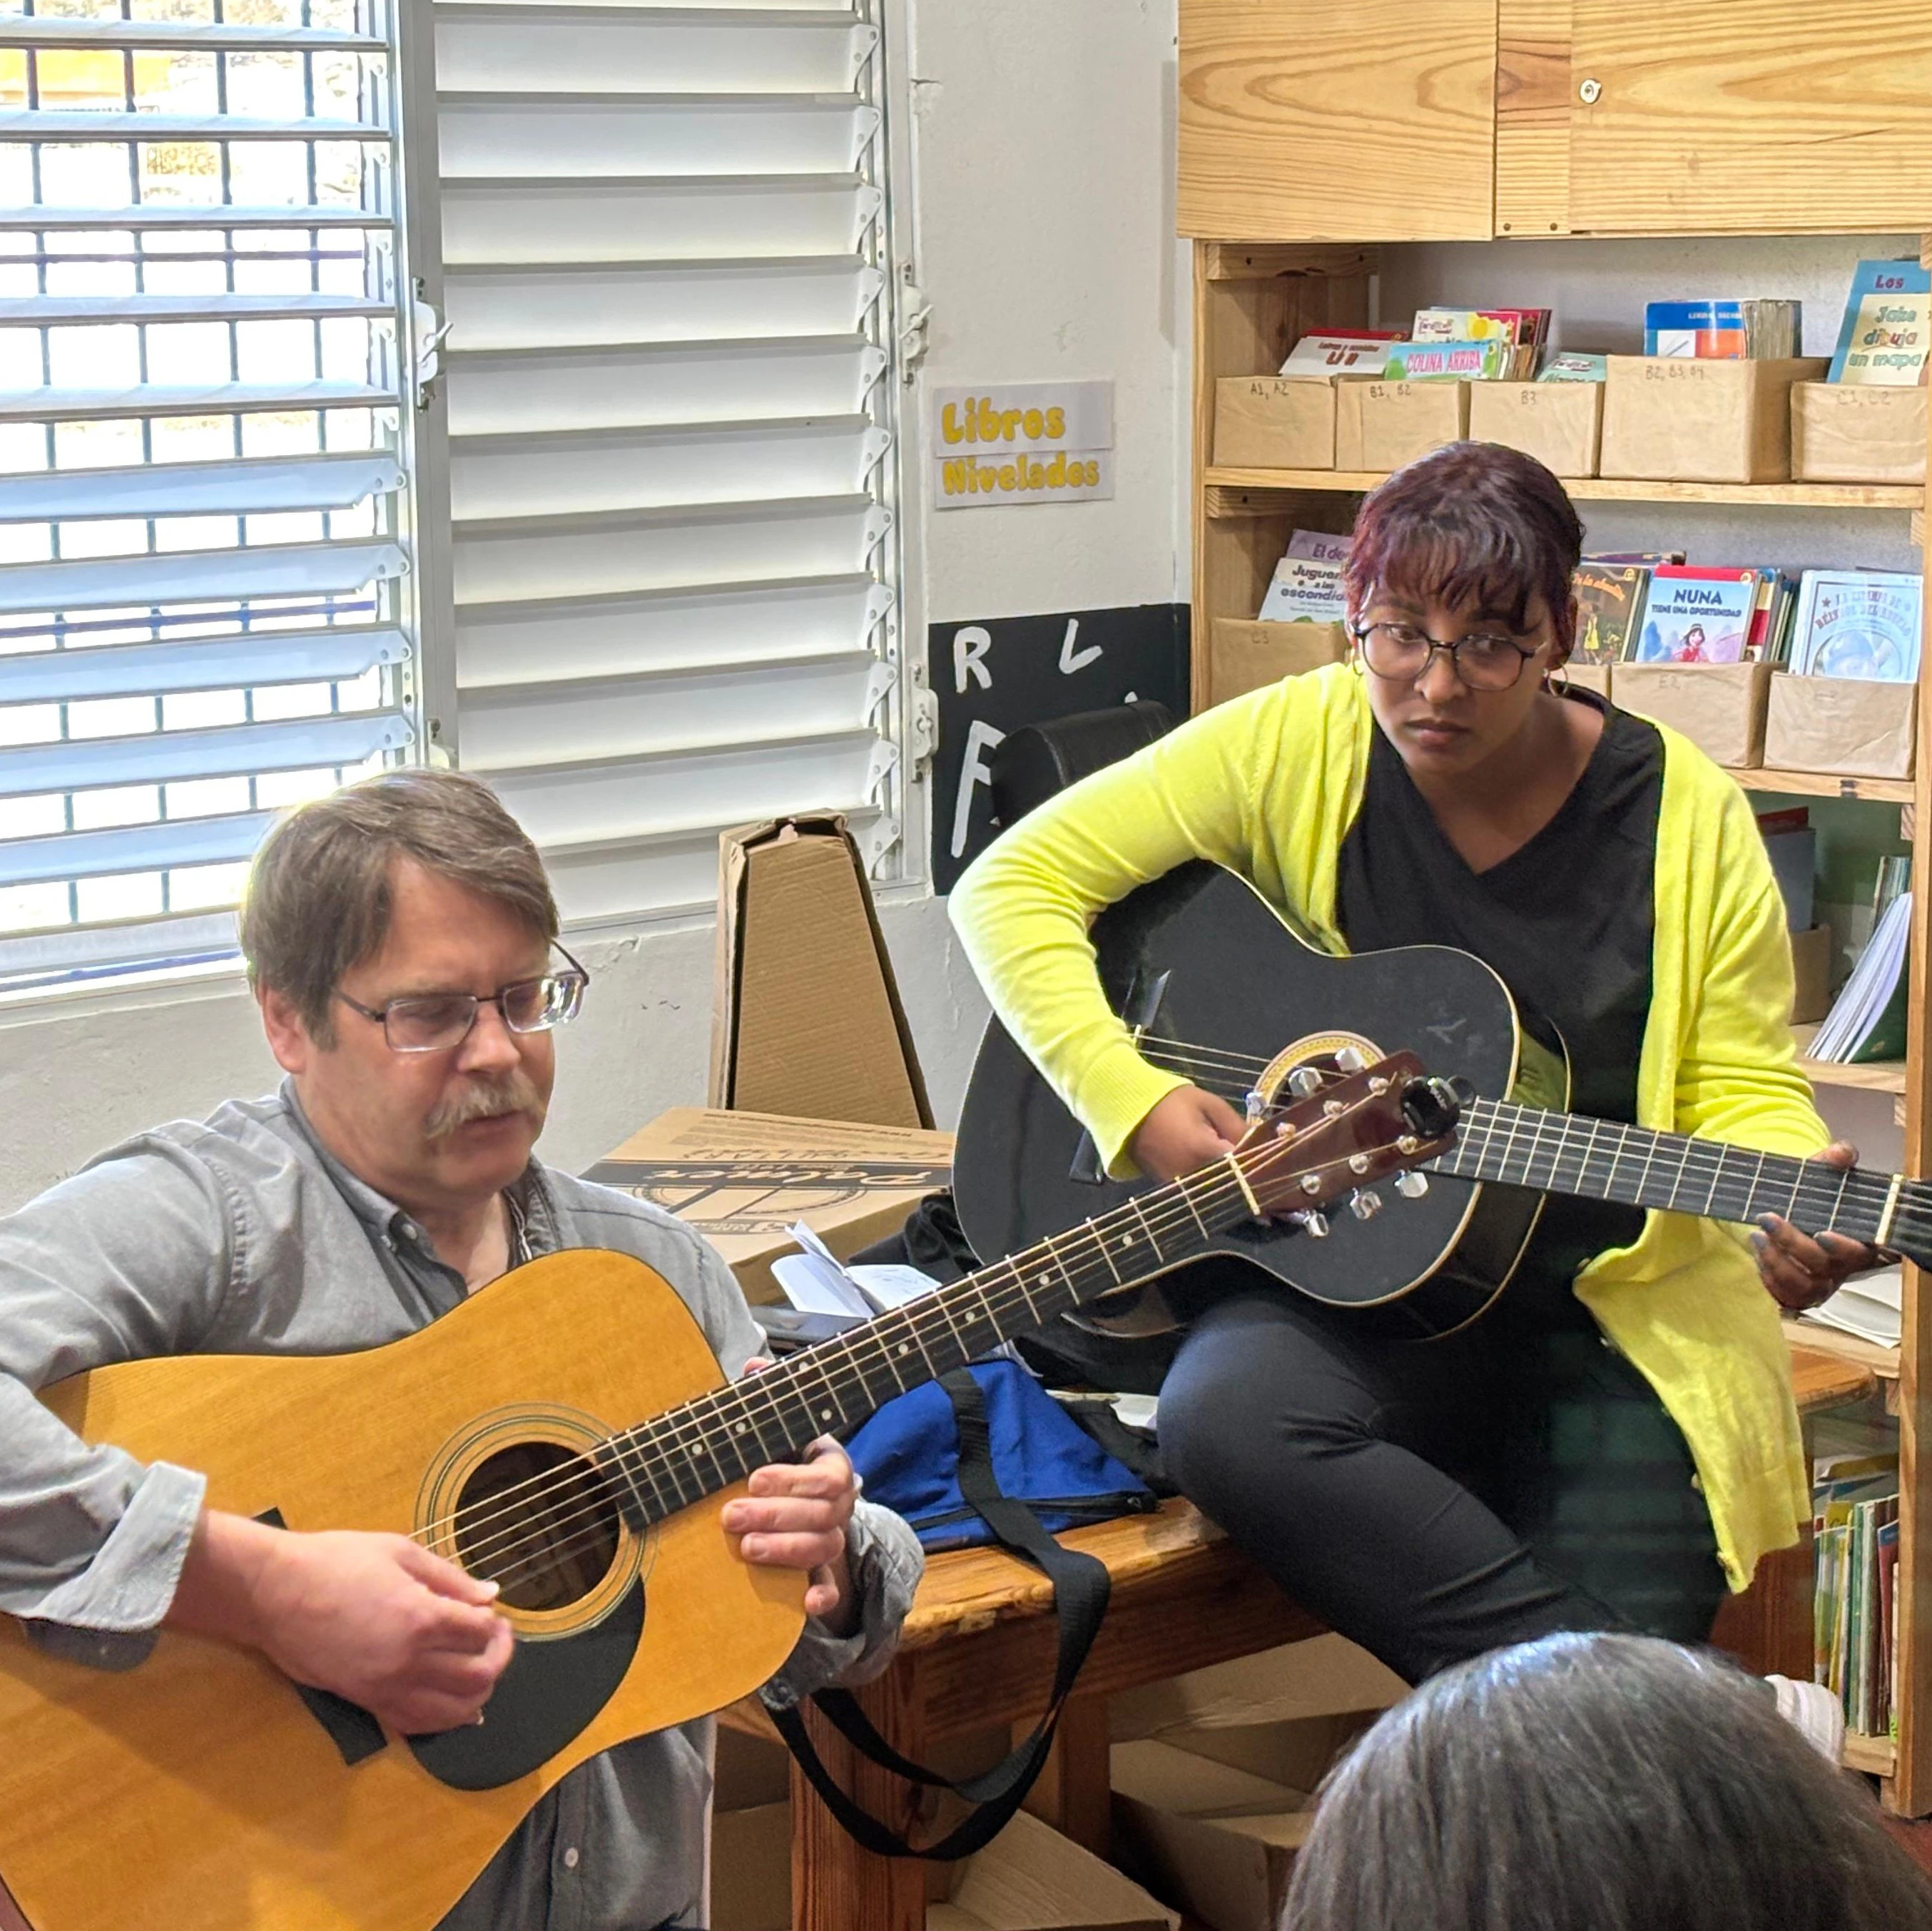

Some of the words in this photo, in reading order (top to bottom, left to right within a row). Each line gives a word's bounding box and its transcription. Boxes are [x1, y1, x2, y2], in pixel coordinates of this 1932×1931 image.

[1875, 275, 1905, 289] Los
[1864, 328, 1918, 348] dibuja
[1406, 353, 1443, 372] COLINA
[1446, 350, 1481, 371] ARRIBA
[1849, 354, 1869, 367] un
[1872, 353, 1922, 370] mapa
[1273, 381, 1290, 397] A2
[941, 397, 1067, 444] Libros
[941, 452, 1101, 496] Nivelados
[1312, 543, 1326, 559] El
[1674, 589, 1723, 605] NUNA
[1652, 604, 1672, 614] TIENE
[1673, 606, 1688, 615] UNA
[1689, 606, 1742, 618] OPORTUNIDAD
[954, 626, 992, 694] R
[647, 1169, 932, 1185] Palmer
